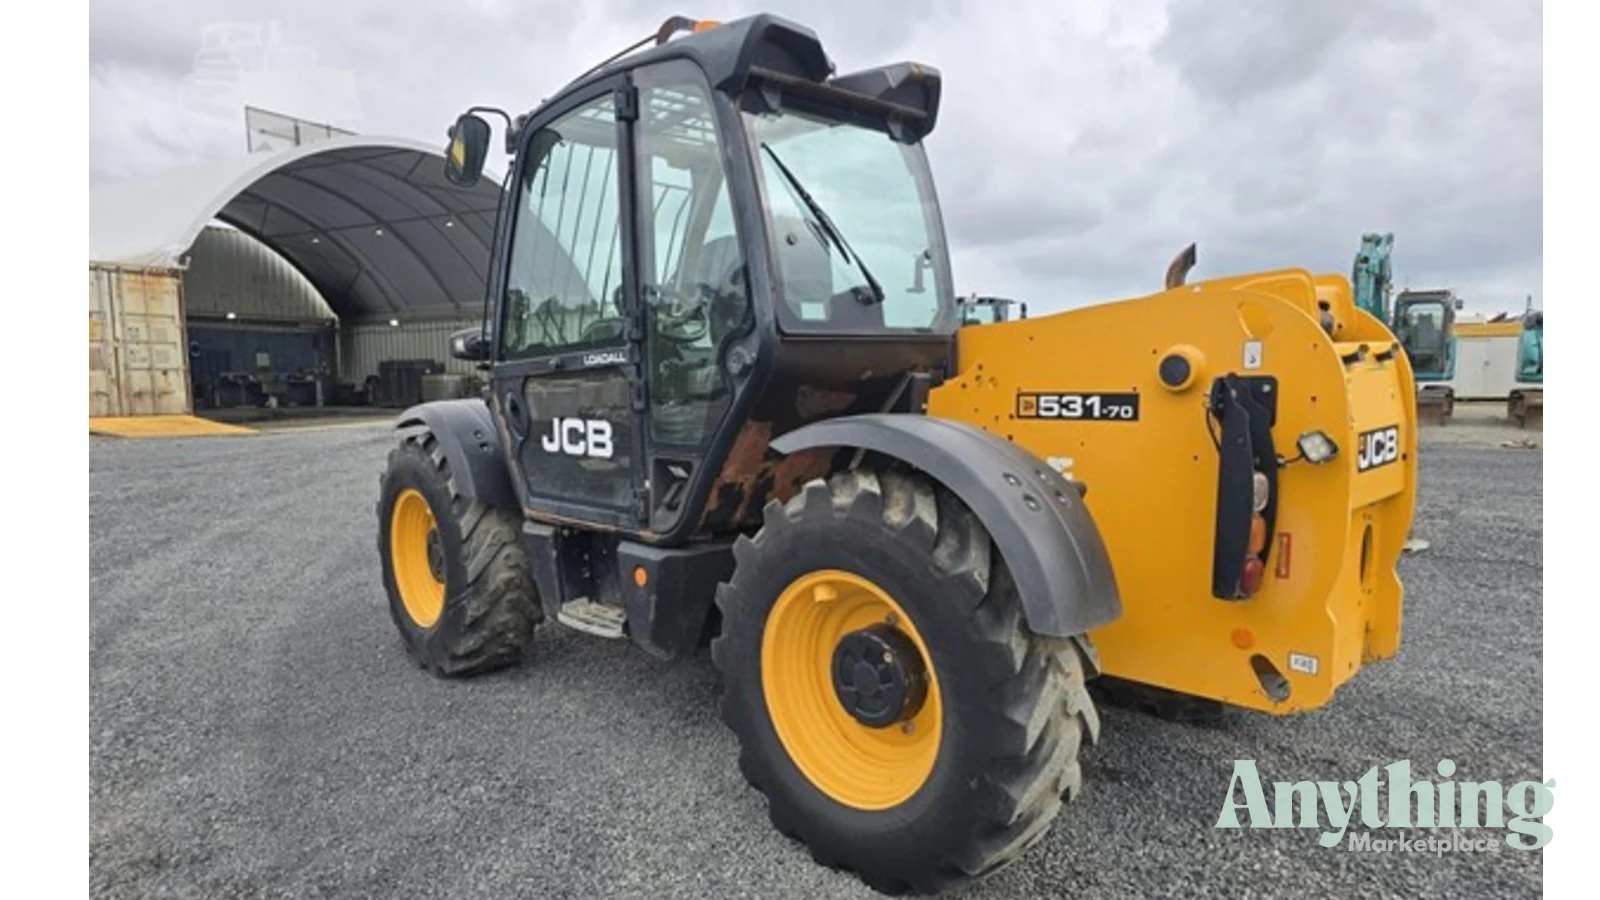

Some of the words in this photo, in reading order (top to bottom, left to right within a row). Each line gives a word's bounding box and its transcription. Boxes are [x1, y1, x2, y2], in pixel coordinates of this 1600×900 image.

[1039, 395, 1133, 418] 531-70
[541, 417, 614, 458] JCB
[1358, 428, 1398, 469] JCB
